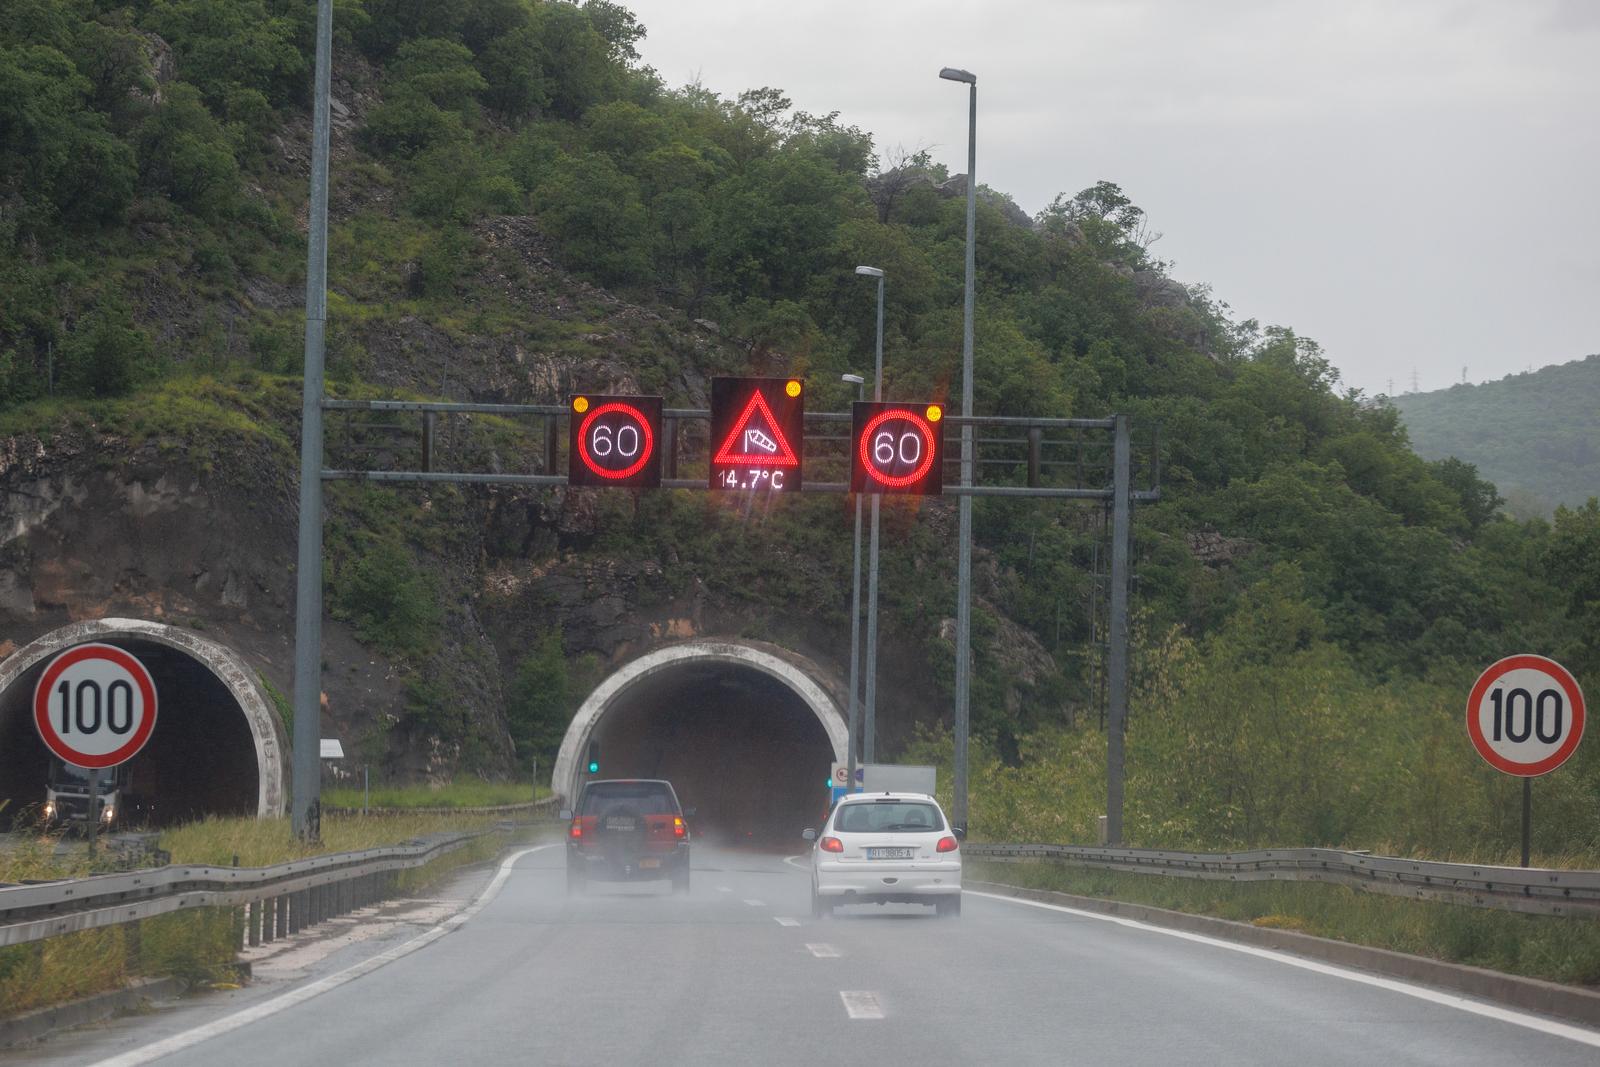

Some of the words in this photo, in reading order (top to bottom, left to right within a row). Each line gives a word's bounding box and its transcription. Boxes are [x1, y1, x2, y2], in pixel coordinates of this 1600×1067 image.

[593, 425, 638, 456] 60
[875, 432, 920, 464] 60
[58, 679, 133, 734] 100
[1490, 687, 1562, 744] 100
